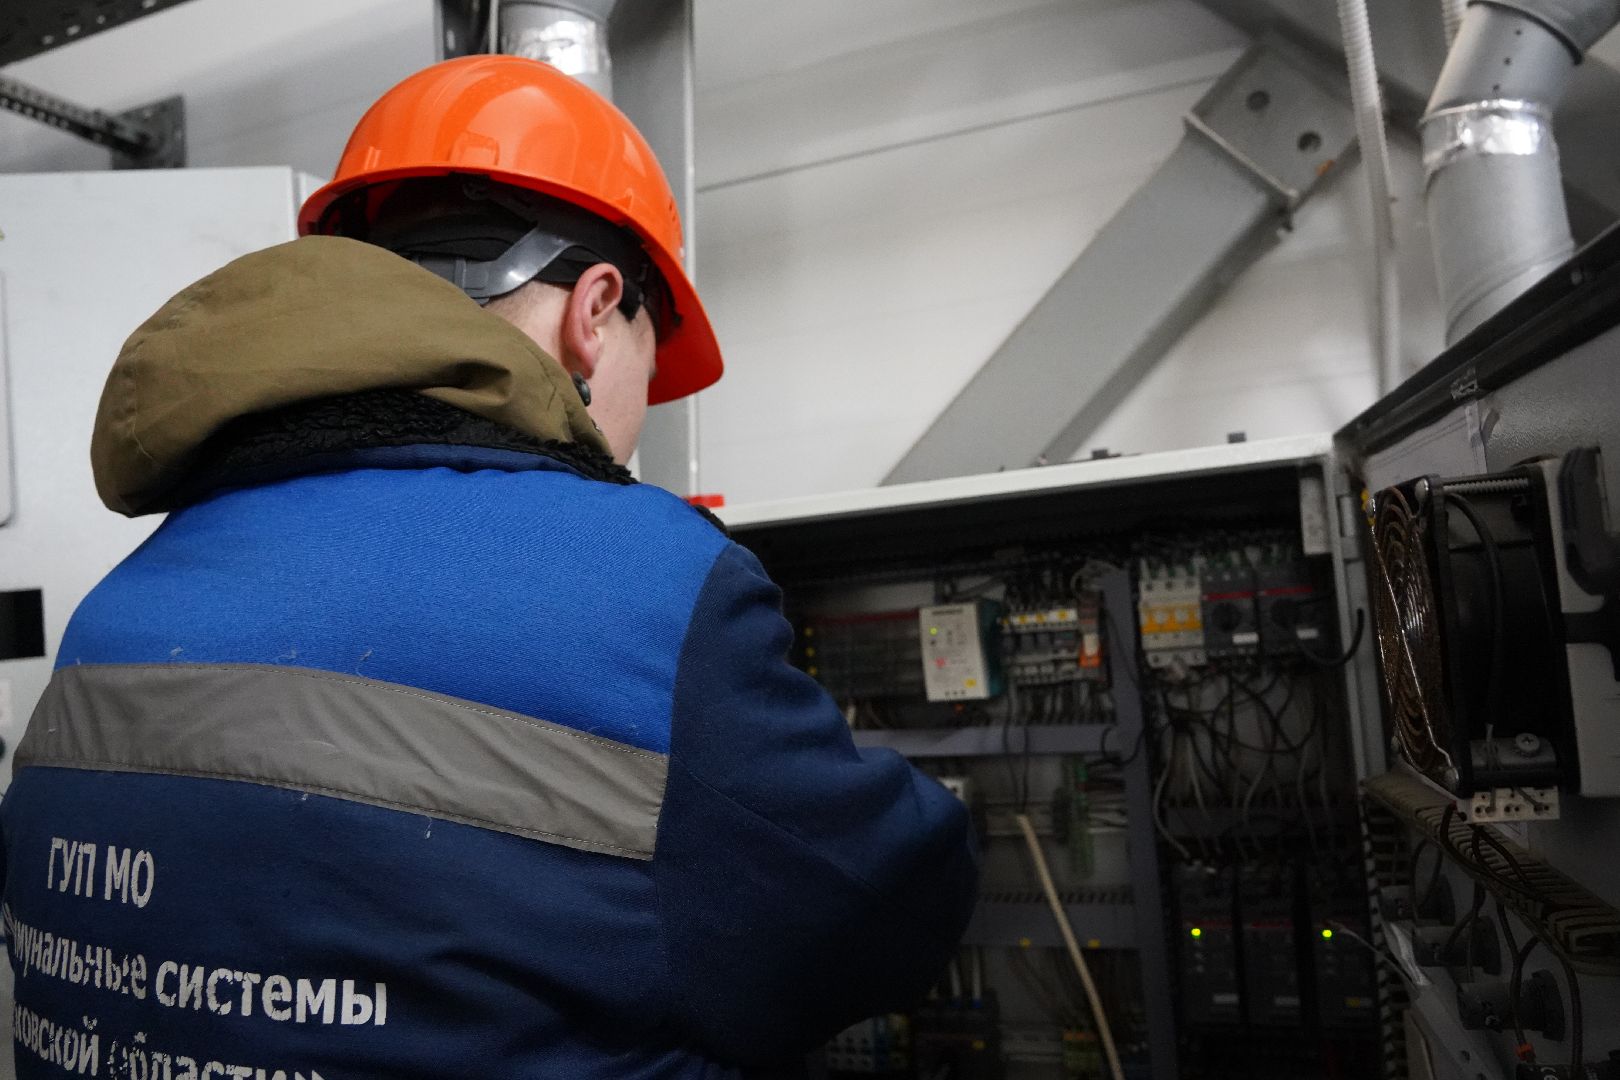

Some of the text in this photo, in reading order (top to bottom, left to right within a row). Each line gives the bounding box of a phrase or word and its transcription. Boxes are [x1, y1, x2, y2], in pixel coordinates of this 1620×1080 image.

[47, 837, 155, 909] ГУП МО
[155, 960, 388, 1026] системы
